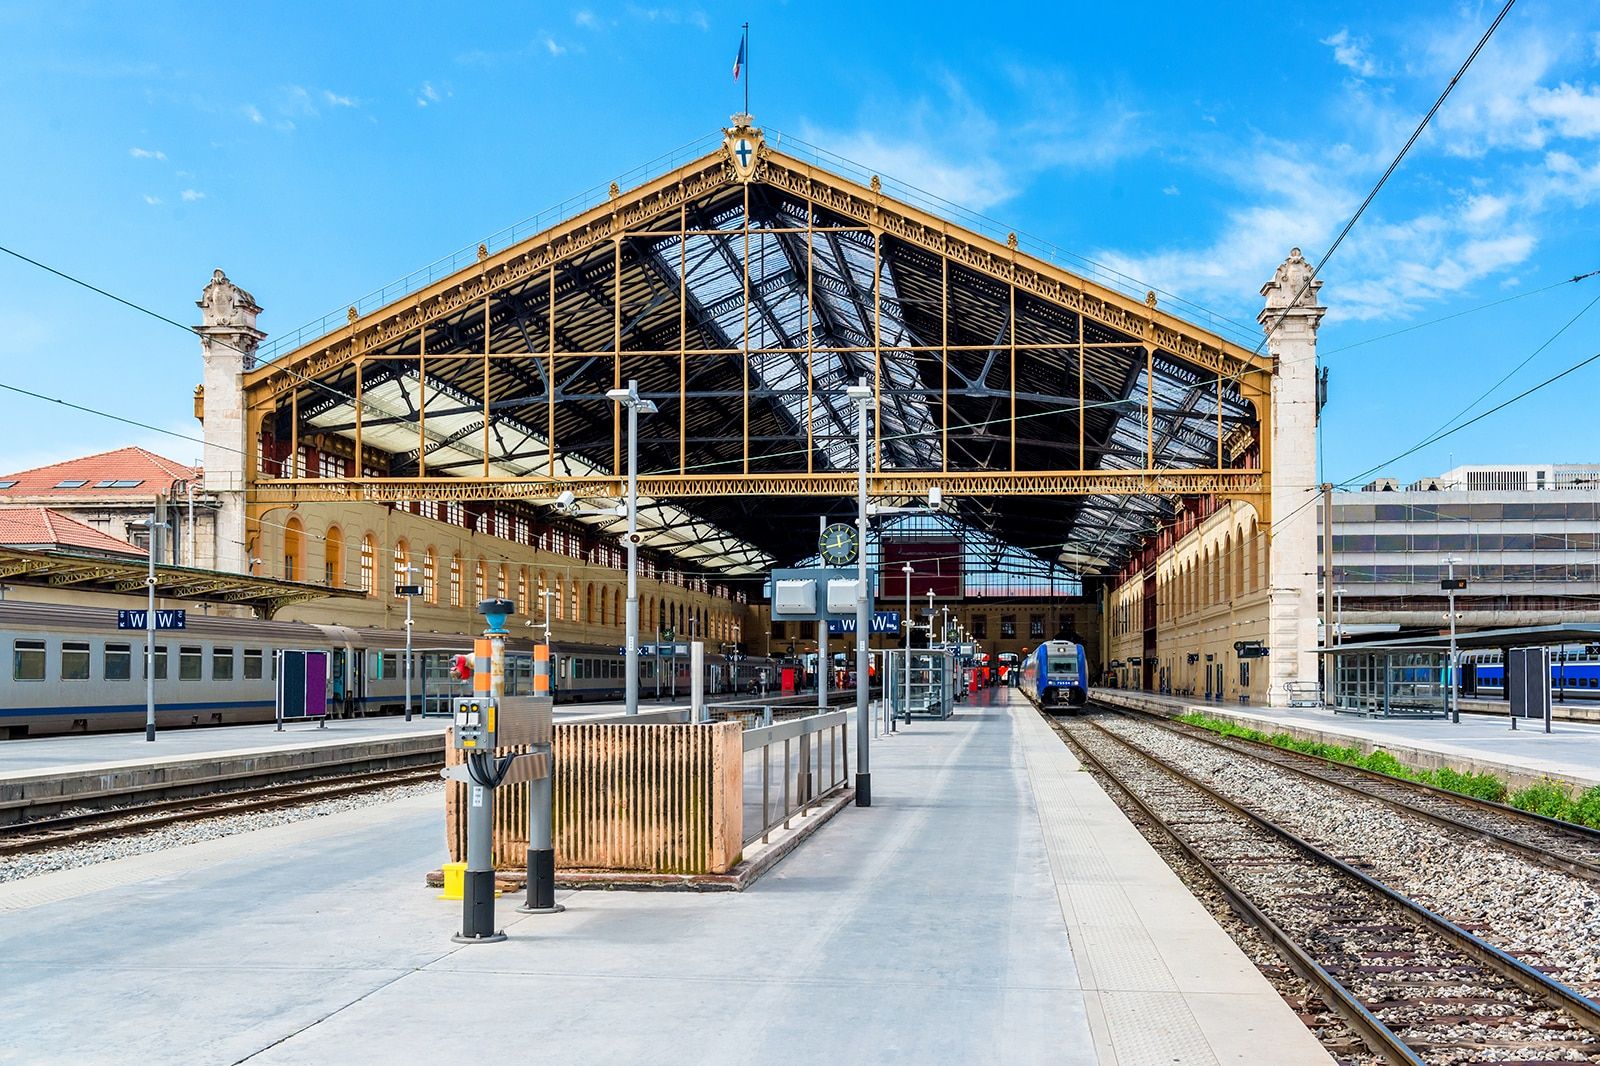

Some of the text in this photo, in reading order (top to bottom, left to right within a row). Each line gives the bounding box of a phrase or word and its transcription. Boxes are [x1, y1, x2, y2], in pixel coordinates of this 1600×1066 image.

[130, 613, 144, 627] W
[158, 613, 172, 627] W
[842, 619, 855, 630] W
[872, 616, 886, 630] W
[637, 647, 643, 655] X
